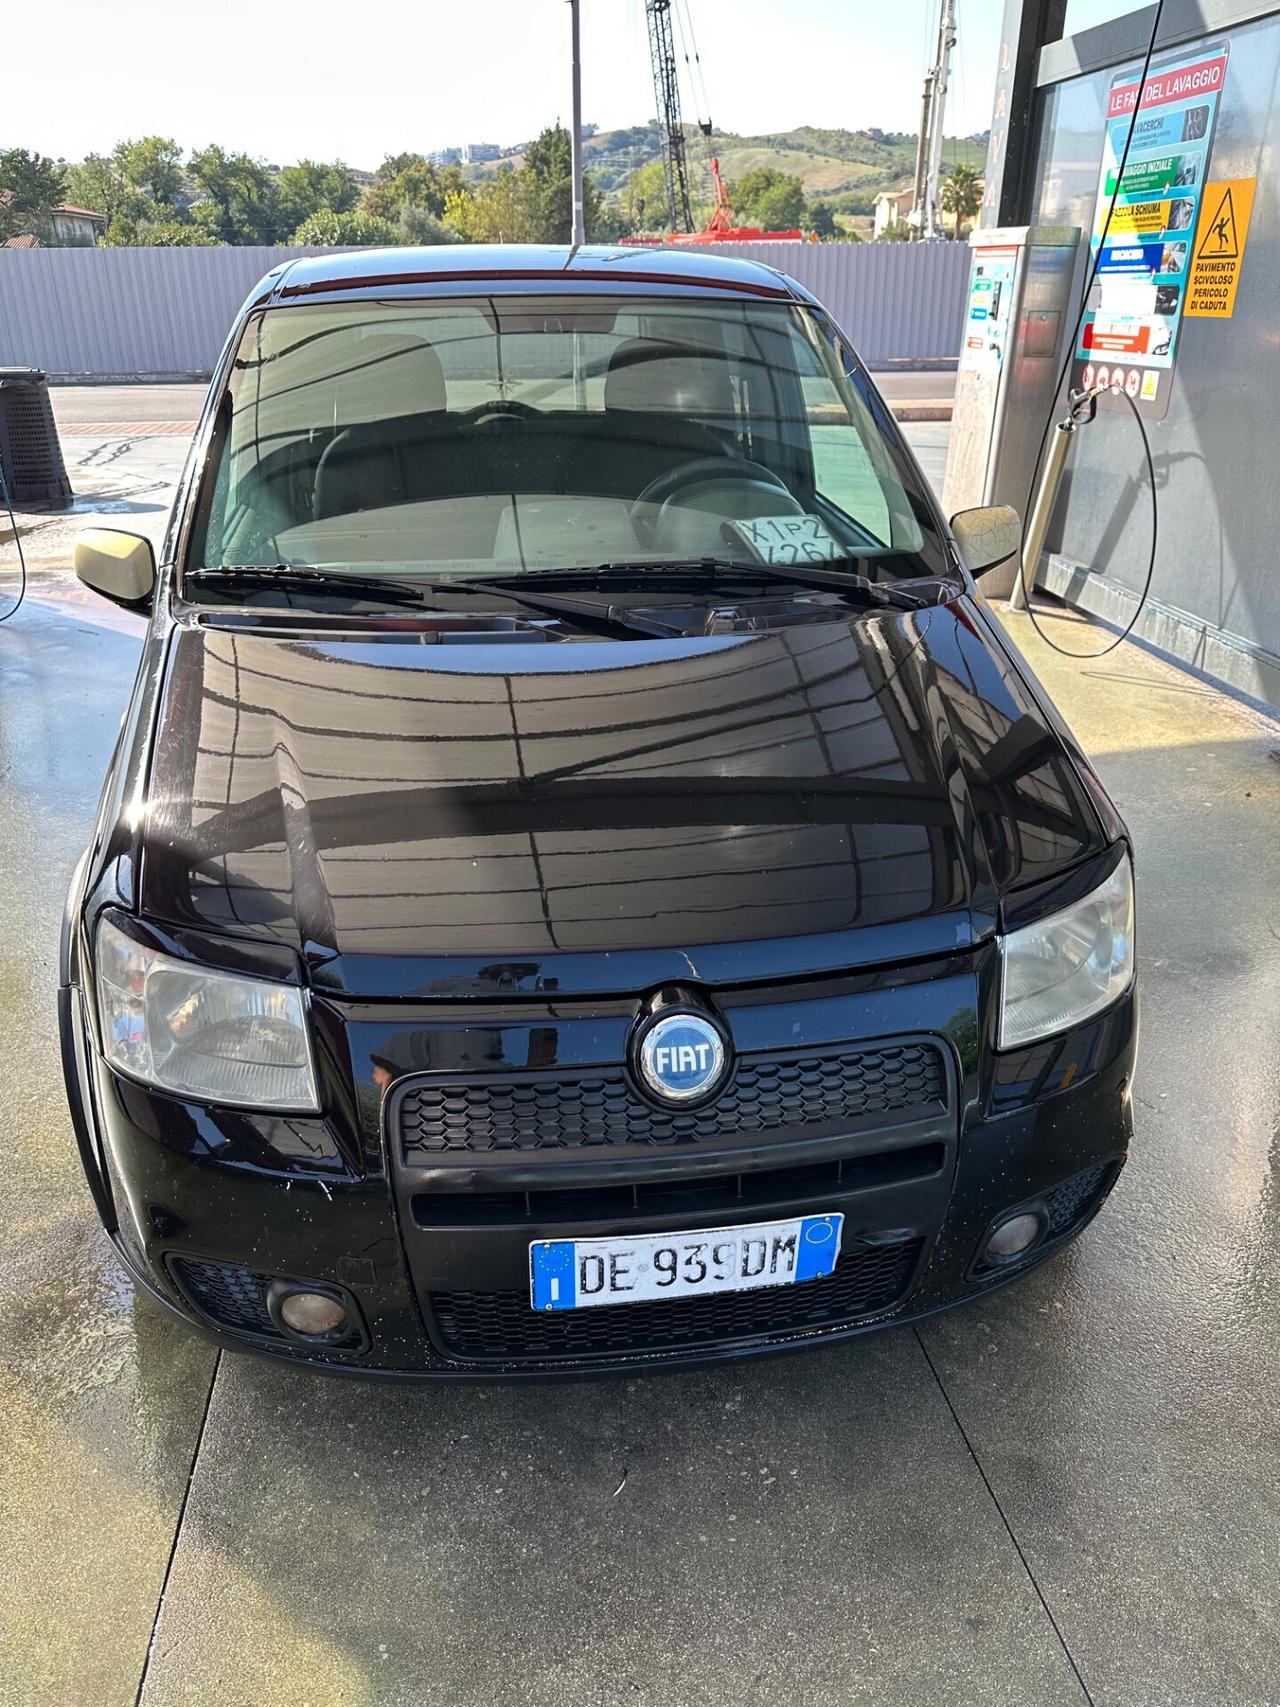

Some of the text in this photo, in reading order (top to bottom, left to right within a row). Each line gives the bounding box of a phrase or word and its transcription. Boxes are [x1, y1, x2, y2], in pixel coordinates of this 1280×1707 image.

[1111, 93, 1124, 111] LE
[1146, 82, 1164, 101] DEL
[1166, 66, 1220, 96] LAVAGGIO
[1196, 262, 1236, 272] PAVIMENTO
[1194, 275, 1233, 285] SCIVOLOSO
[1193, 288, 1229, 298] PERICOLO
[1190, 300, 1227, 310] DI CADUTA
[656, 1043, 710, 1074] FIAT
[579, 1249, 636, 1295] DE
